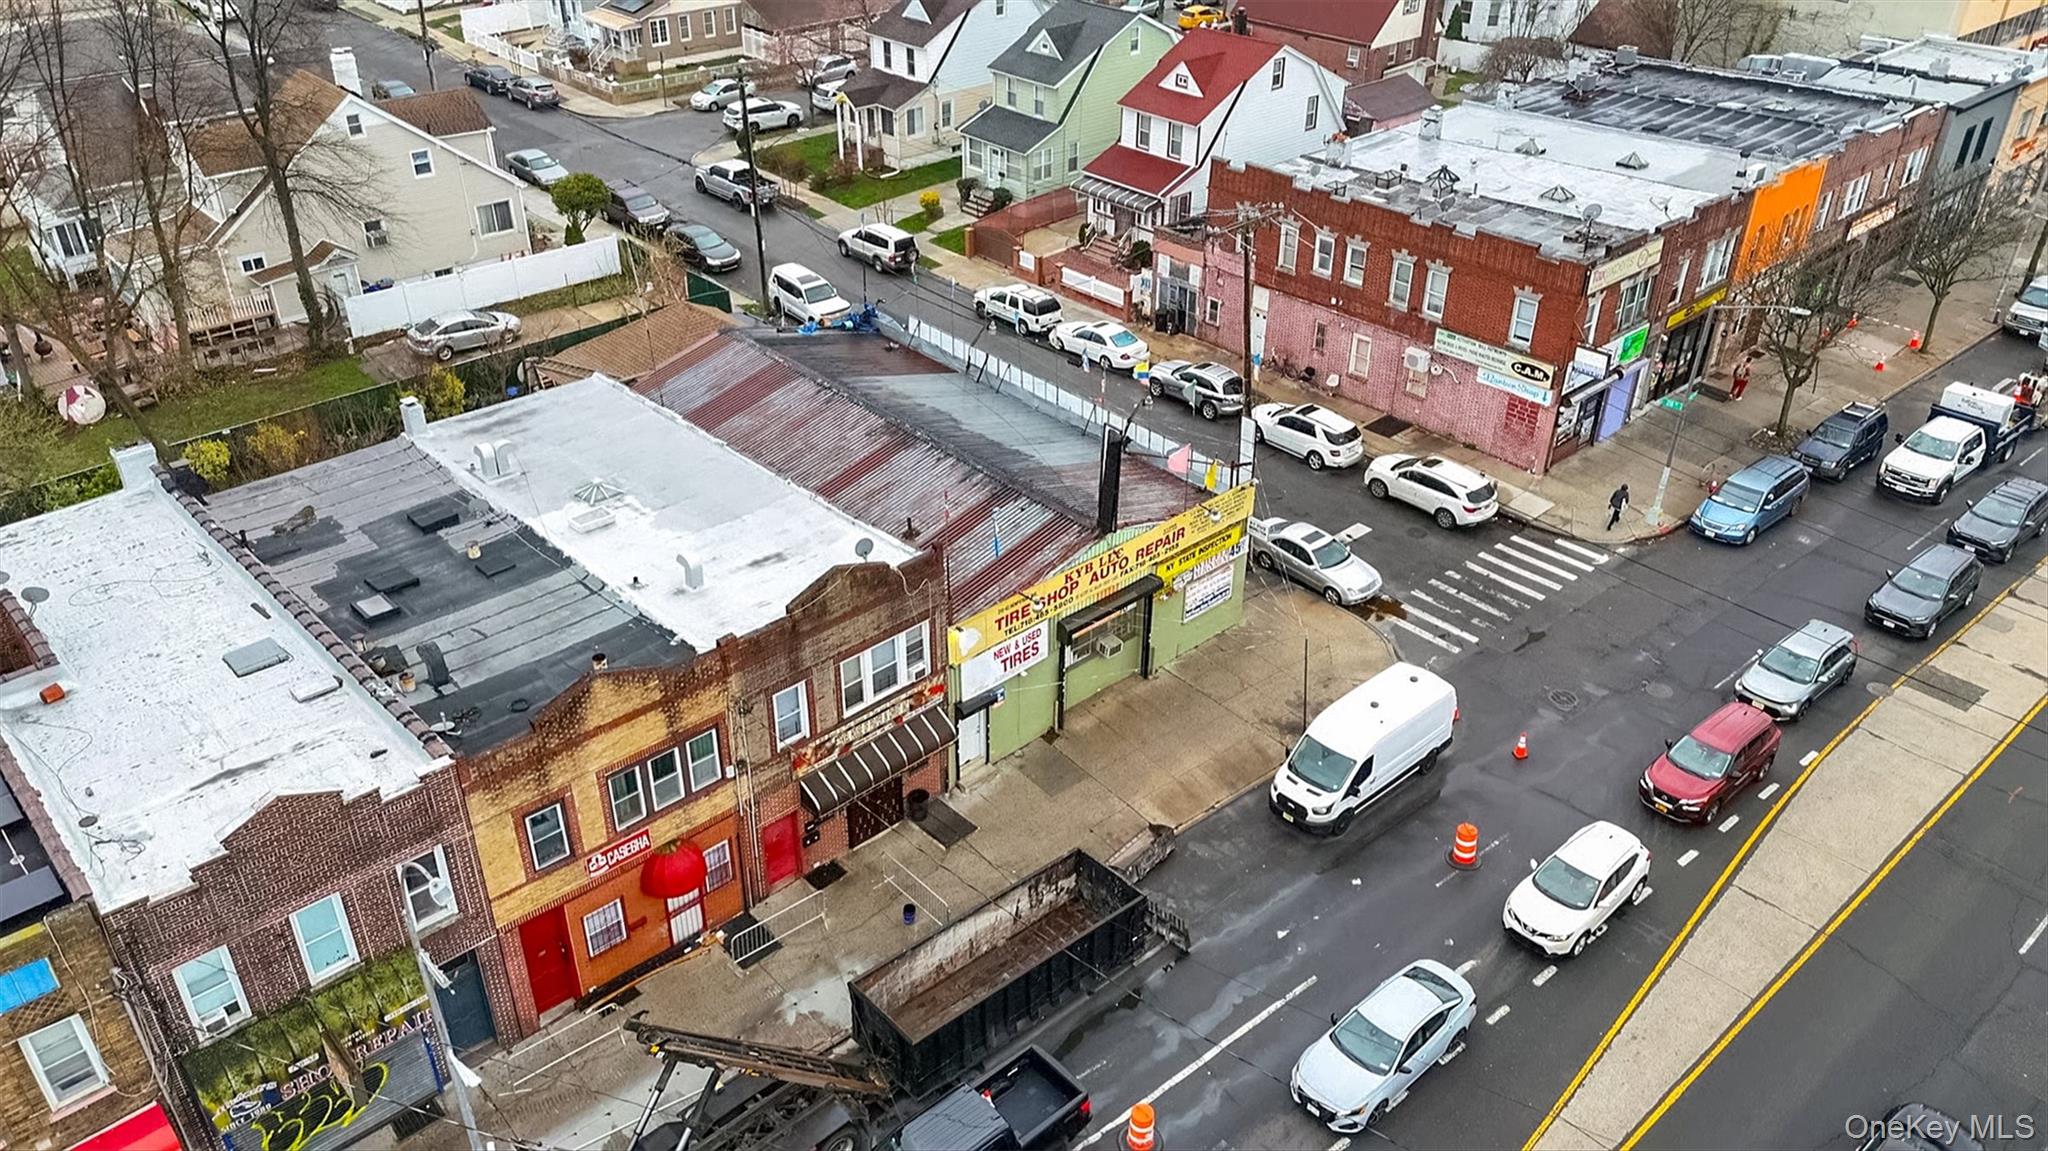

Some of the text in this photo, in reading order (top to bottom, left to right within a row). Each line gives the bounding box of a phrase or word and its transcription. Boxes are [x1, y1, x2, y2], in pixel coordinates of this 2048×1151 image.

[1513, 363, 1547, 382] C.A.M.
[1166, 561, 1175, 571] NY
[1179, 550, 1197, 566] STATE
[1198, 533, 1232, 555] INSPECTION
[995, 603, 1031, 631] TIRE
[1039, 581, 1079, 609] SHOP
[1089, 557, 1129, 585] AUTO
[1136, 527, 1186, 562] REPAIR
[1064, 562, 1093, 584] KYB
[993, 643, 1011, 661] NEW
[1022, 628, 1042, 645] USED
[1000, 641, 1039, 672] TIRES
